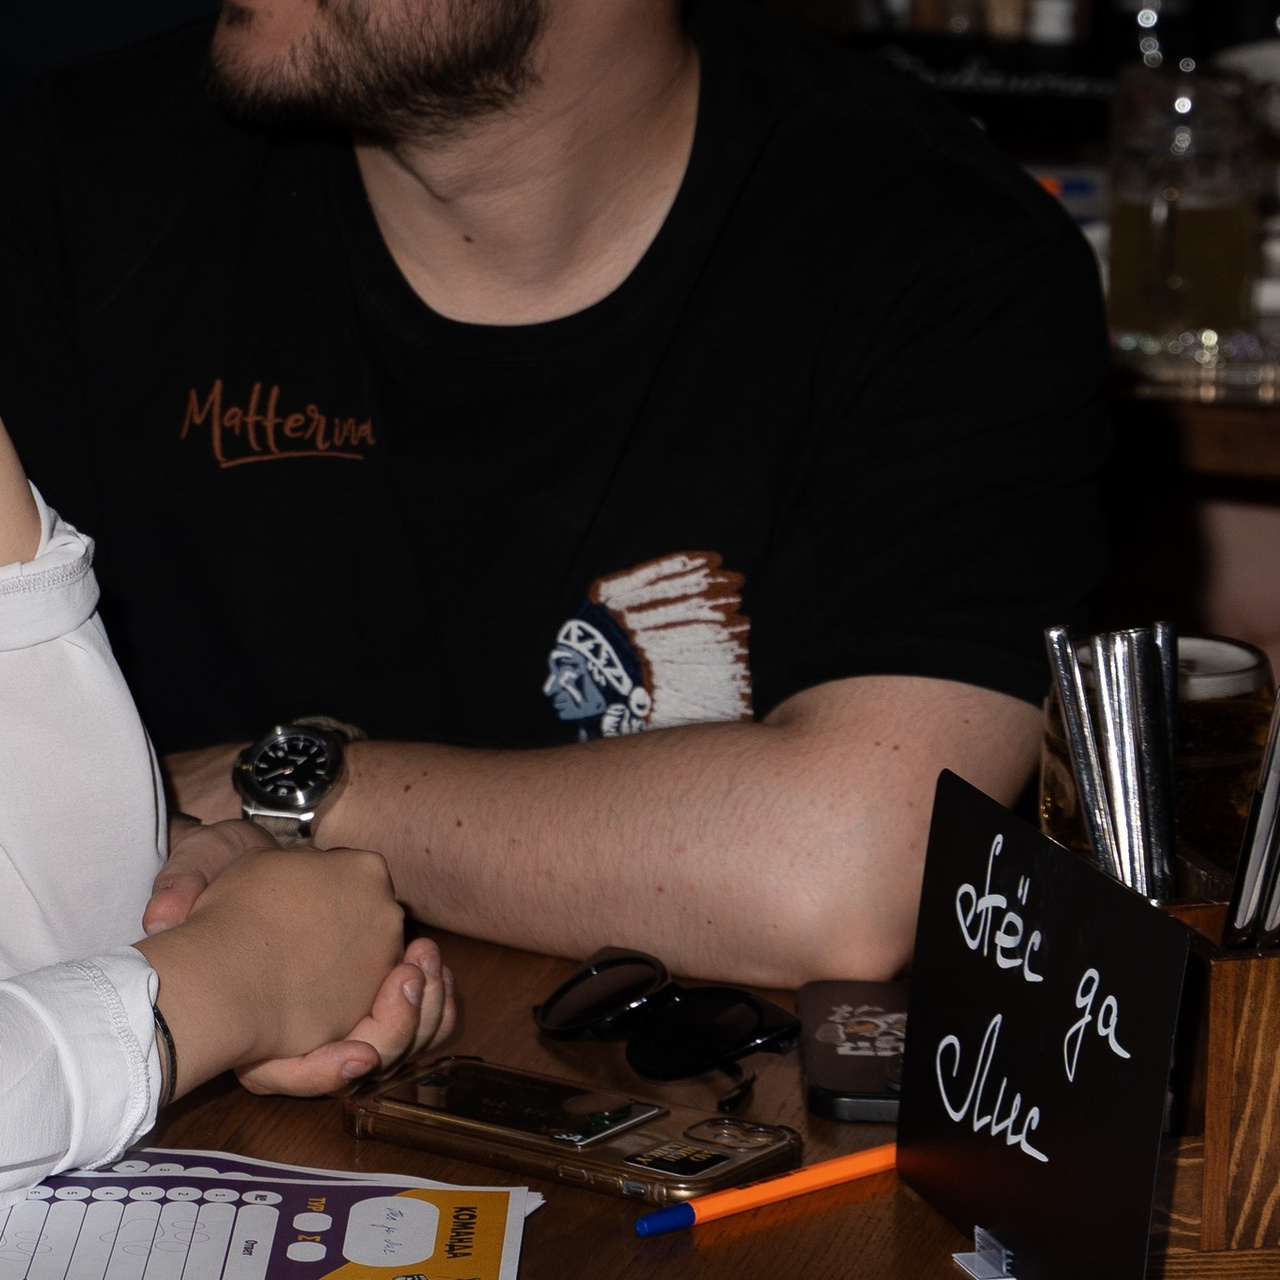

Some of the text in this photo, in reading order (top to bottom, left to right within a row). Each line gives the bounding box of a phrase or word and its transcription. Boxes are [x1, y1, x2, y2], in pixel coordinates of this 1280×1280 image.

[307, 1197, 326, 1211] ТУР
[446, 1207, 477, 1258] КОМАНДА
[243, 1240, 257, 1256] Ответ
